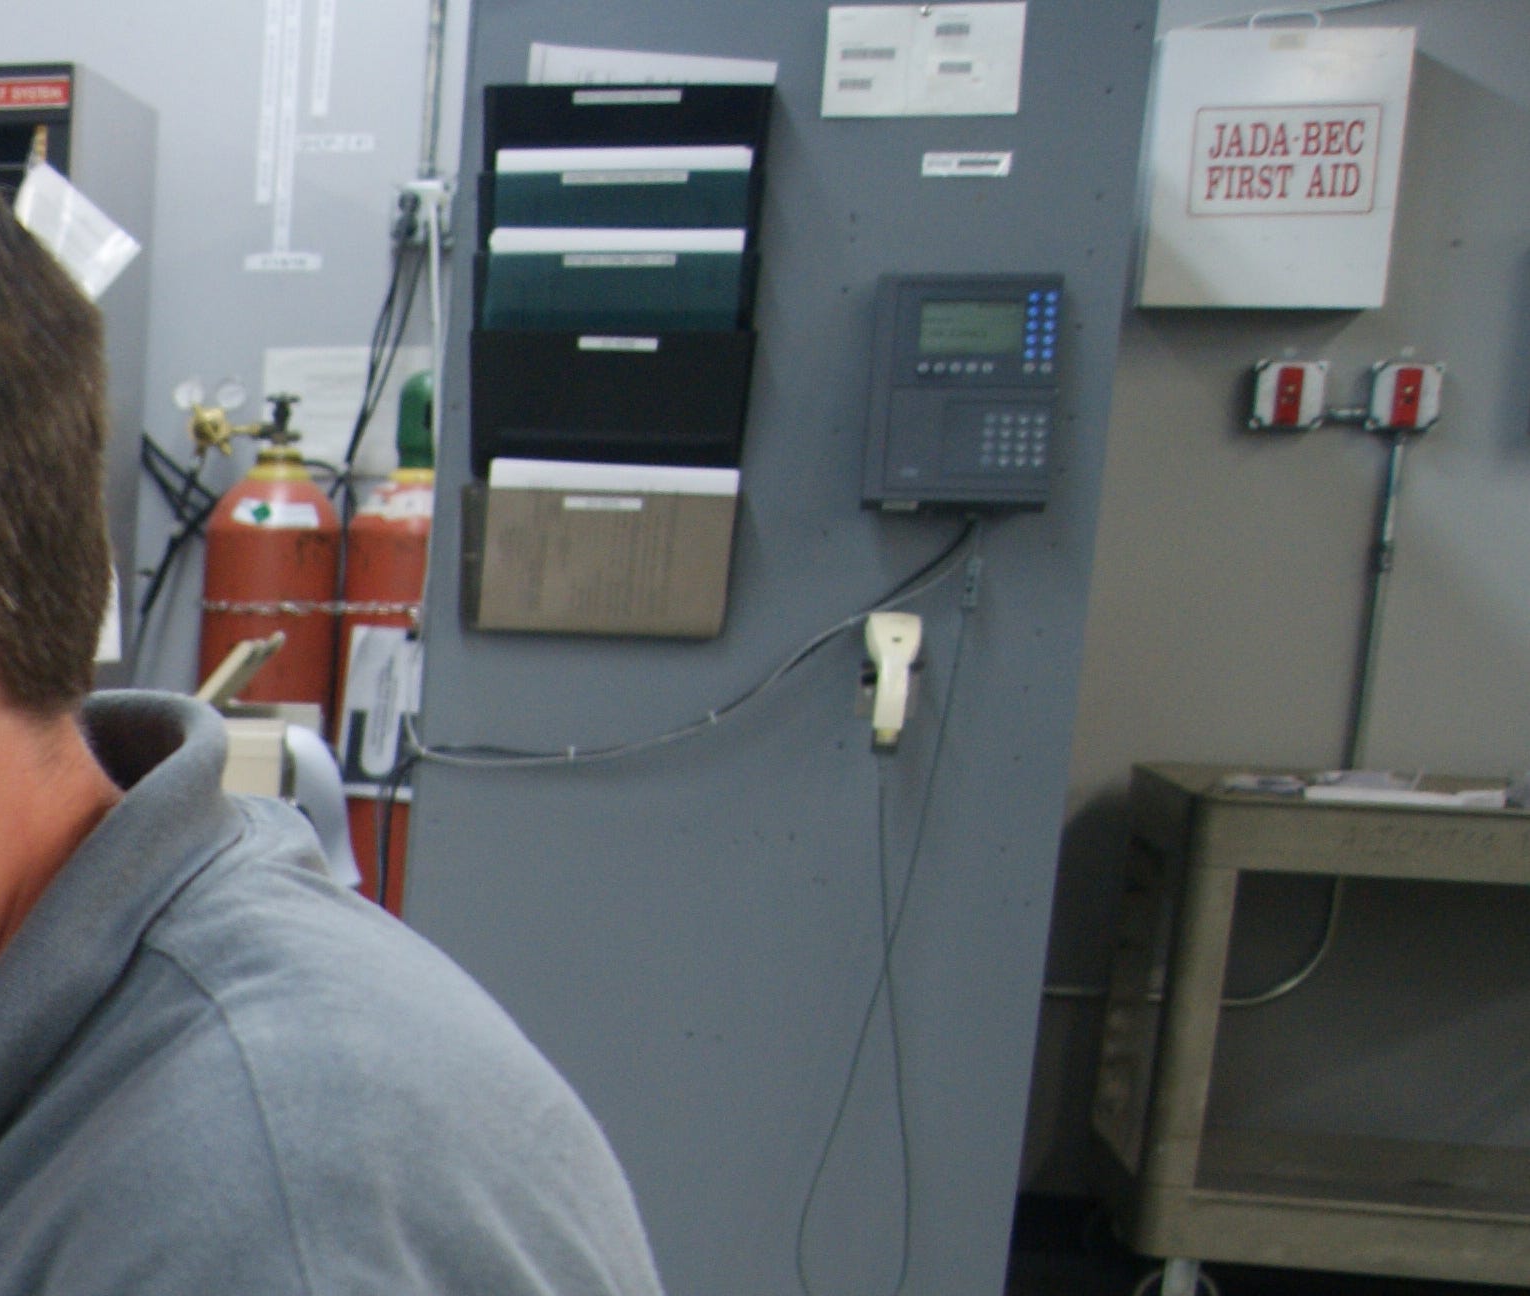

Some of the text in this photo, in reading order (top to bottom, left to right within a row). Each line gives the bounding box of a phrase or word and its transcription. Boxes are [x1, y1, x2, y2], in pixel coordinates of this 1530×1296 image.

[11, 85, 62, 101] SYSTEM
[1208, 119, 1366, 159] JADA-BEC
[1204, 162, 1361, 201] FIRST AID
